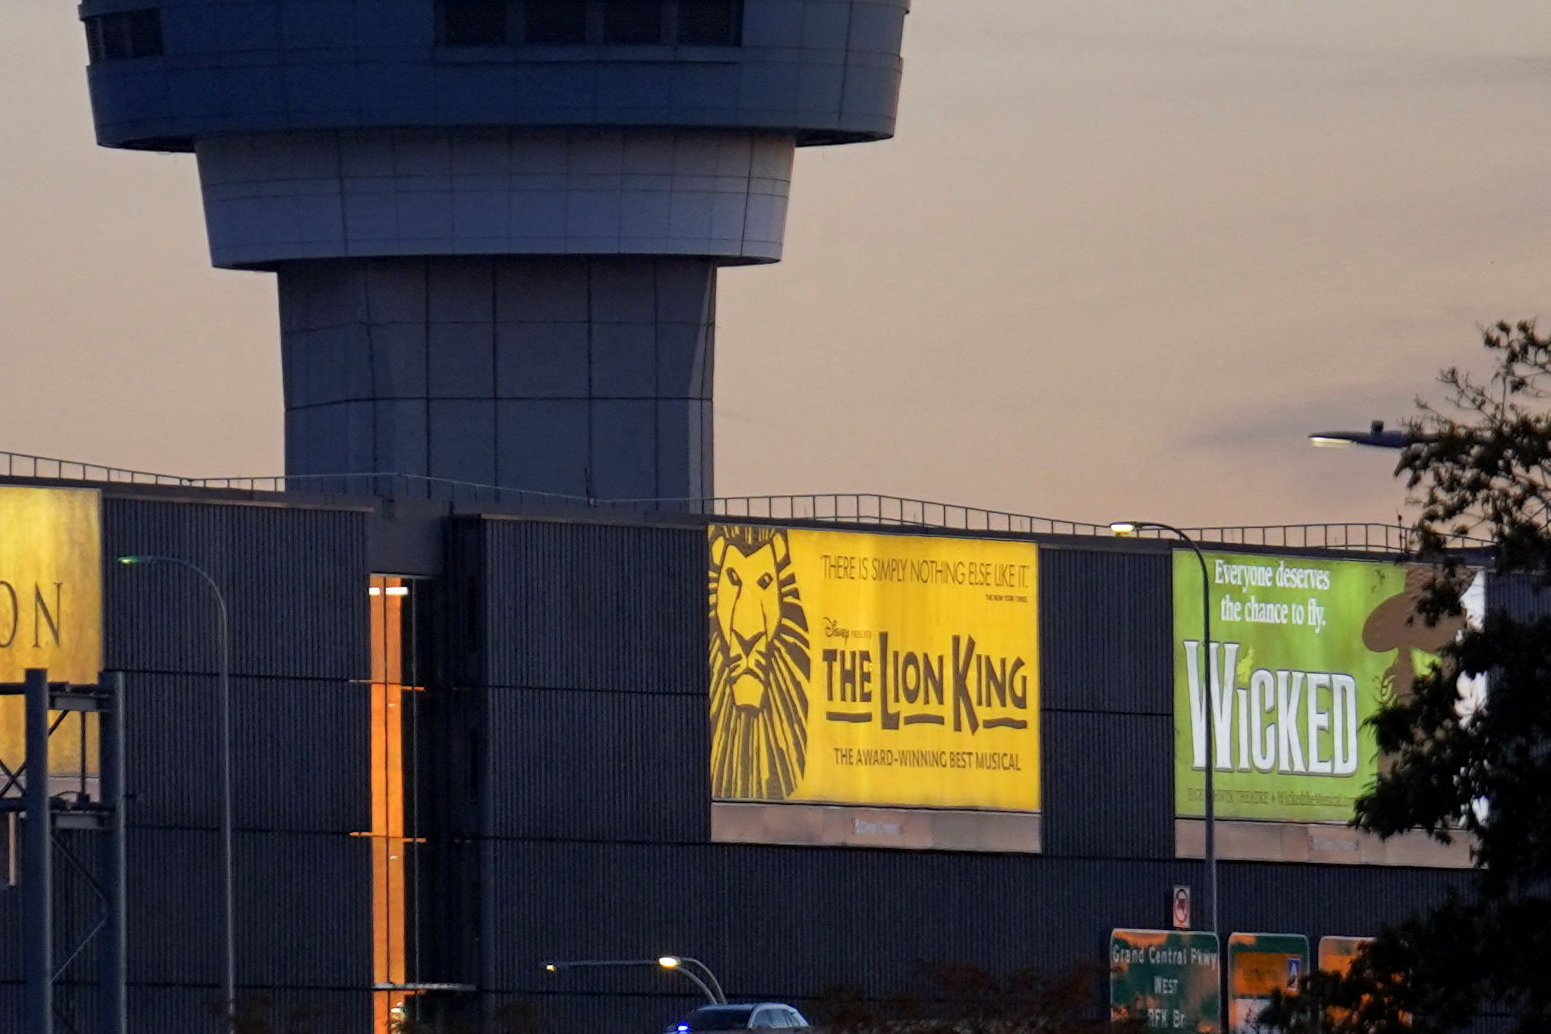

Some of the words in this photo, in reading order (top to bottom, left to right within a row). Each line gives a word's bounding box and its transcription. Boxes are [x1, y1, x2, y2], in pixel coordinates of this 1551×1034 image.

[858, 557, 868, 580] IS
[871, 557, 908, 582] SIMPLY
[910, 560, 965, 585] NOTHING
[968, 561, 991, 586] ELSE
[994, 563, 1015, 588] LIKE
[1214, 559, 1273, 593] Everyone
[1275, 560, 1331, 590] deserves
[1220, 594, 1242, 622] the
[1244, 595, 1289, 624] chance
[1291, 602, 1305, 625] to
[1307, 597, 1327, 634] fly.
[822, 616, 850, 646] Disney
[822, 649, 872, 703] THE
[834, 748, 854, 766] THE
[856, 749, 948, 769] AWARD-WINNING
[950, 751, 973, 769] BEST
[975, 752, 1022, 772] MUSICAL
[1112, 945, 1145, 964] Grand
[1148, 946, 1187, 965] Central
[1190, 948, 1219, 971] Pkwy
[1154, 976, 1179, 994] WEST
[1147, 1009, 1168, 1027] RFK
[1172, 1009, 1186, 1028] Br
